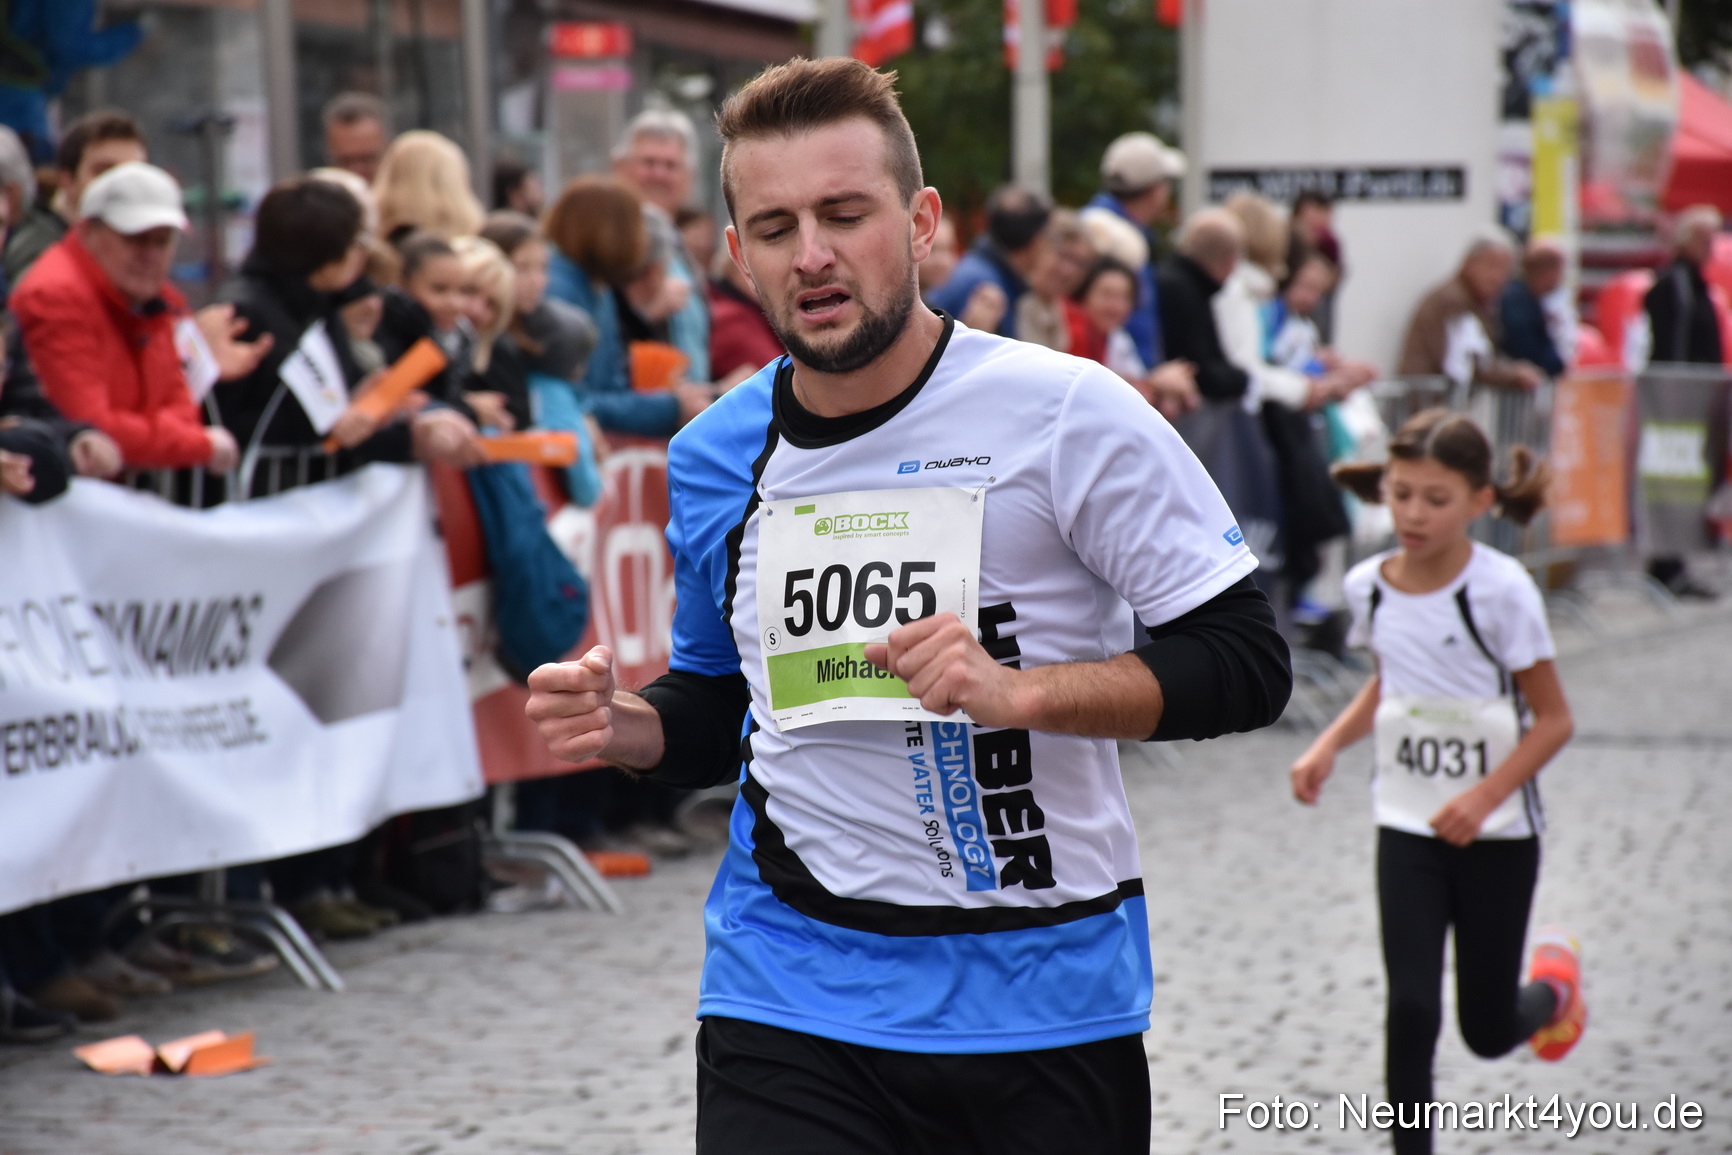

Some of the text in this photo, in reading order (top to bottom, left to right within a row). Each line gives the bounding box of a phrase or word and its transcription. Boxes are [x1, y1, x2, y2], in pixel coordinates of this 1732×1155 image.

[833, 512, 909, 534] BOCK
[833, 532, 854, 540] inspired
[784, 561, 937, 637] 5065
[817, 655, 895, 684] Michae
[978, 601, 1057, 890] HBER
[1397, 737, 1486, 778] 4031
[908, 752, 935, 815] WATER
[938, 722, 990, 878] CHNOLOGY
